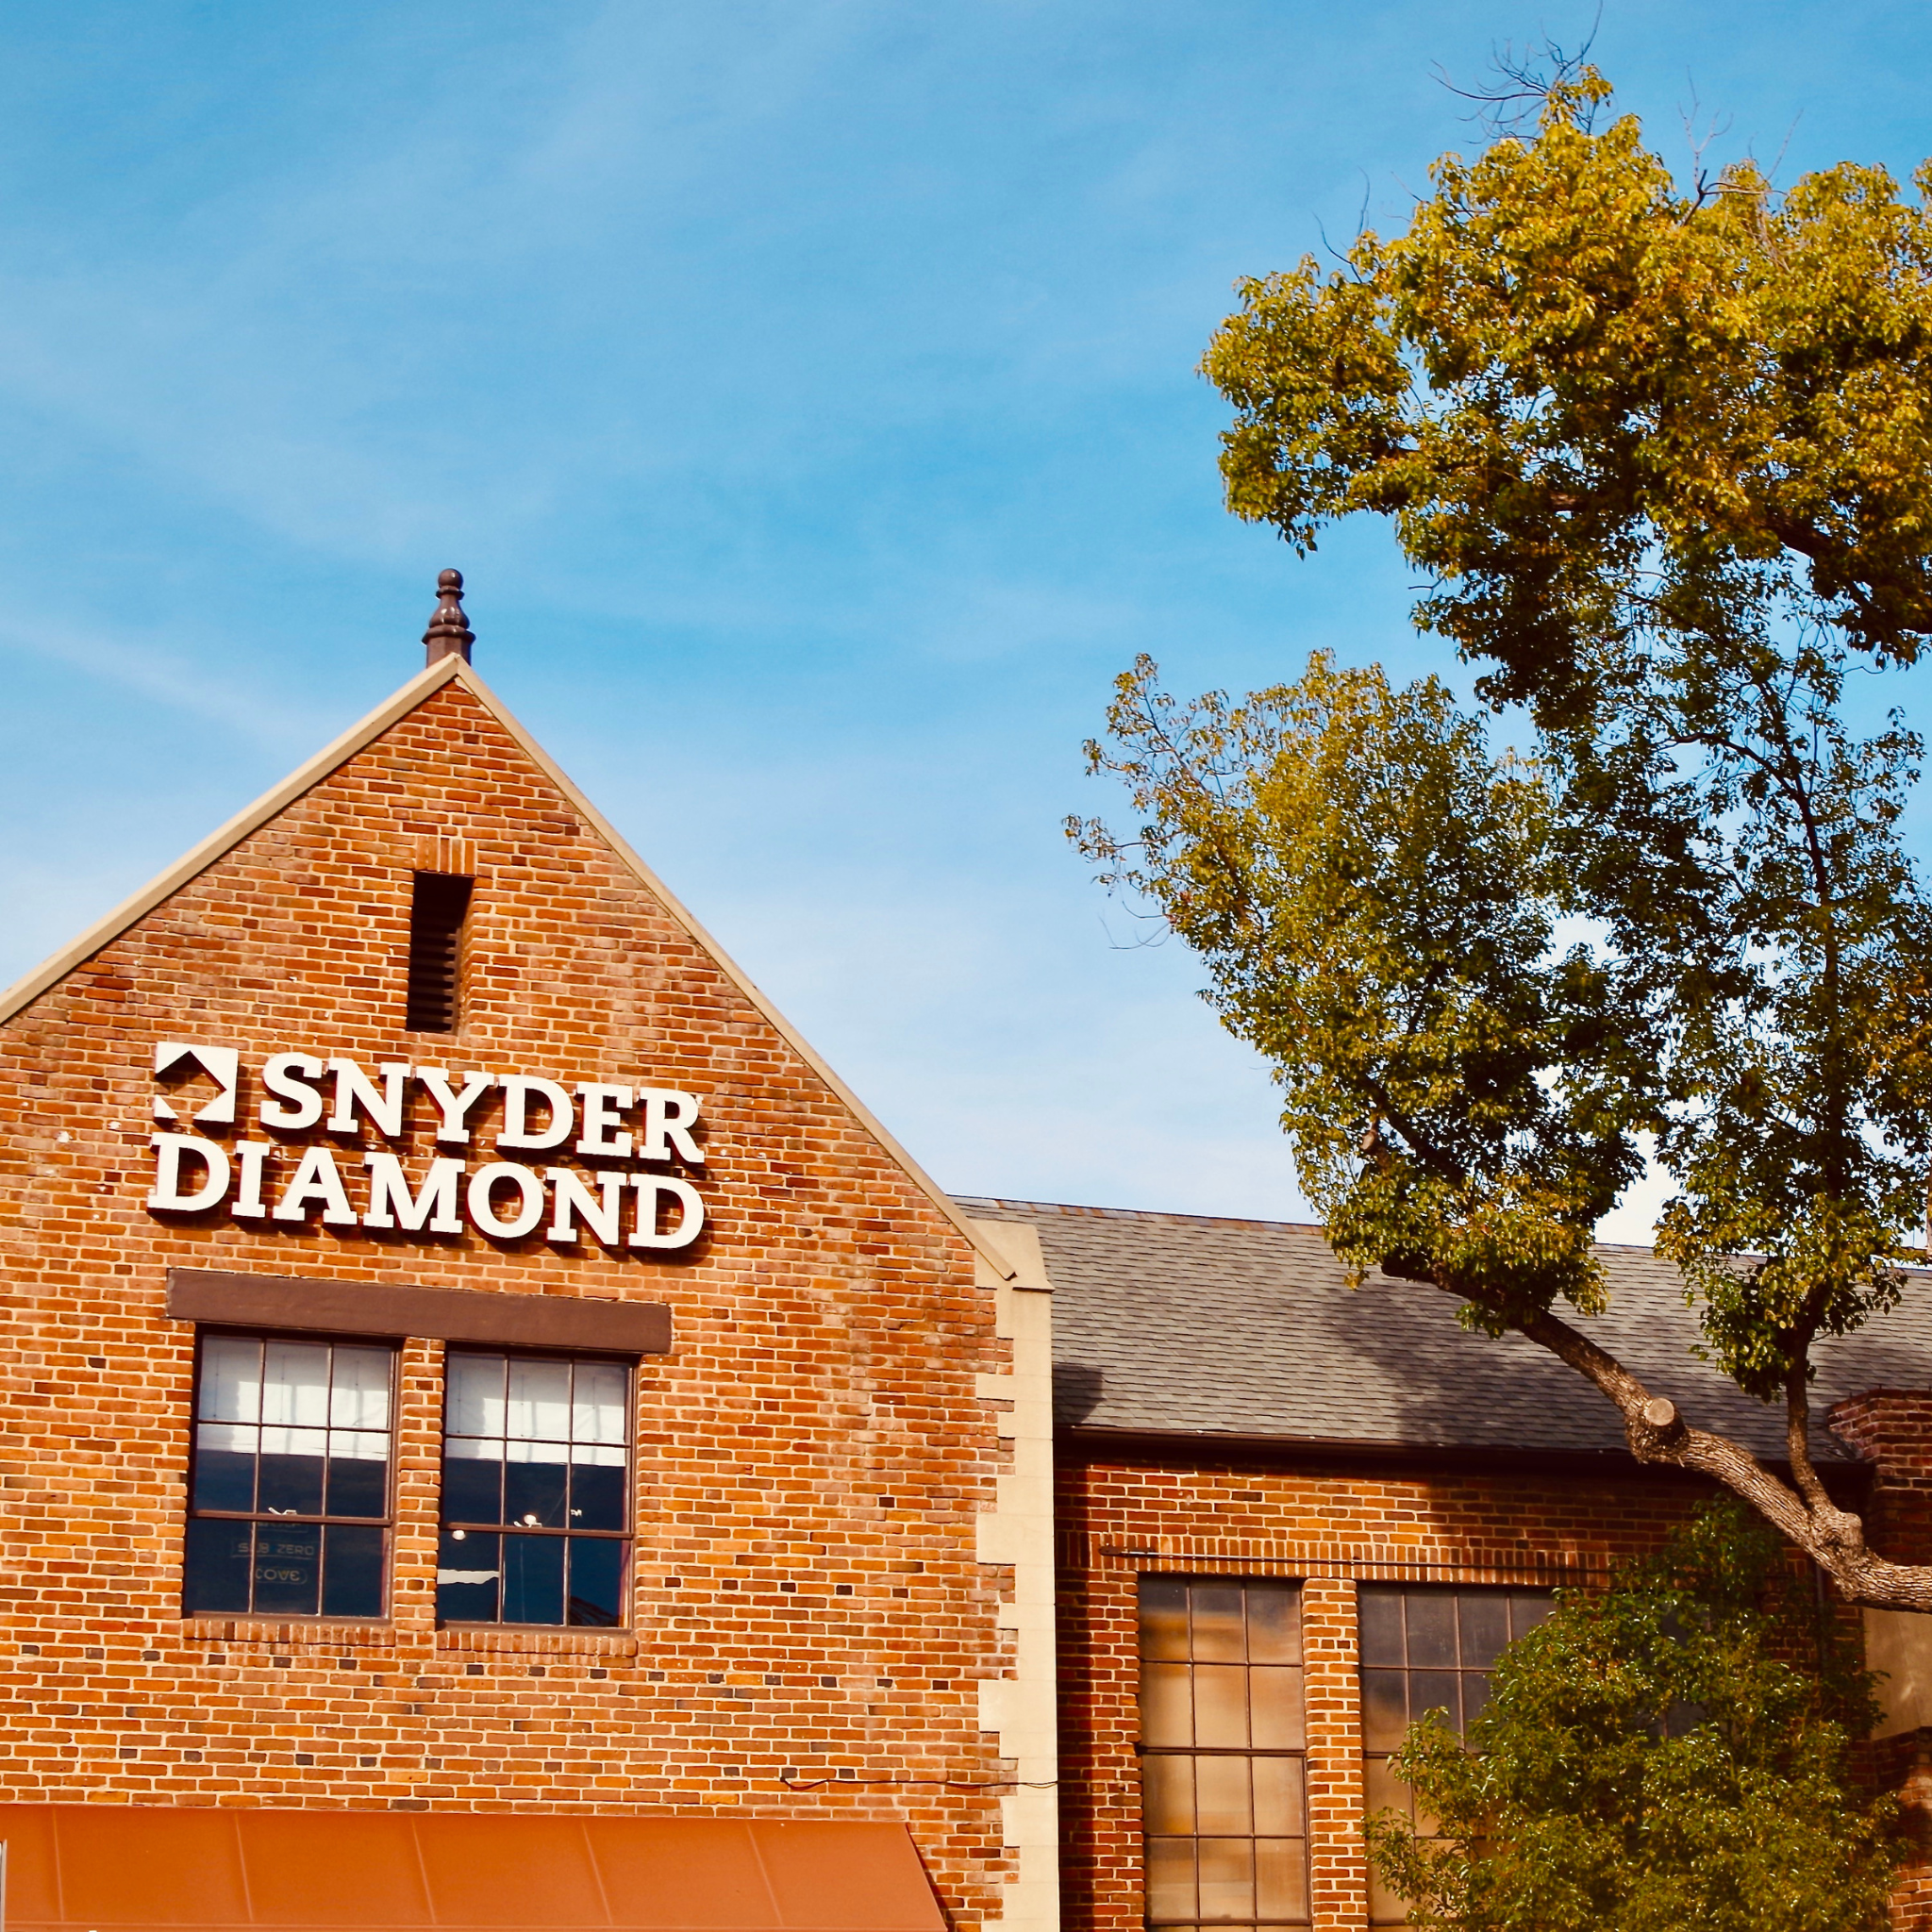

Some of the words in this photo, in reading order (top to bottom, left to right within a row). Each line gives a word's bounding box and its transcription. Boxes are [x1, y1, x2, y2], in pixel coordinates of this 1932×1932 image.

[259, 1052, 705, 1163] SNYDER
[146, 1132, 705, 1249] DIAMOND
[255, 1568, 300, 1582] COVE
[277, 1543, 314, 1556] ZERO
